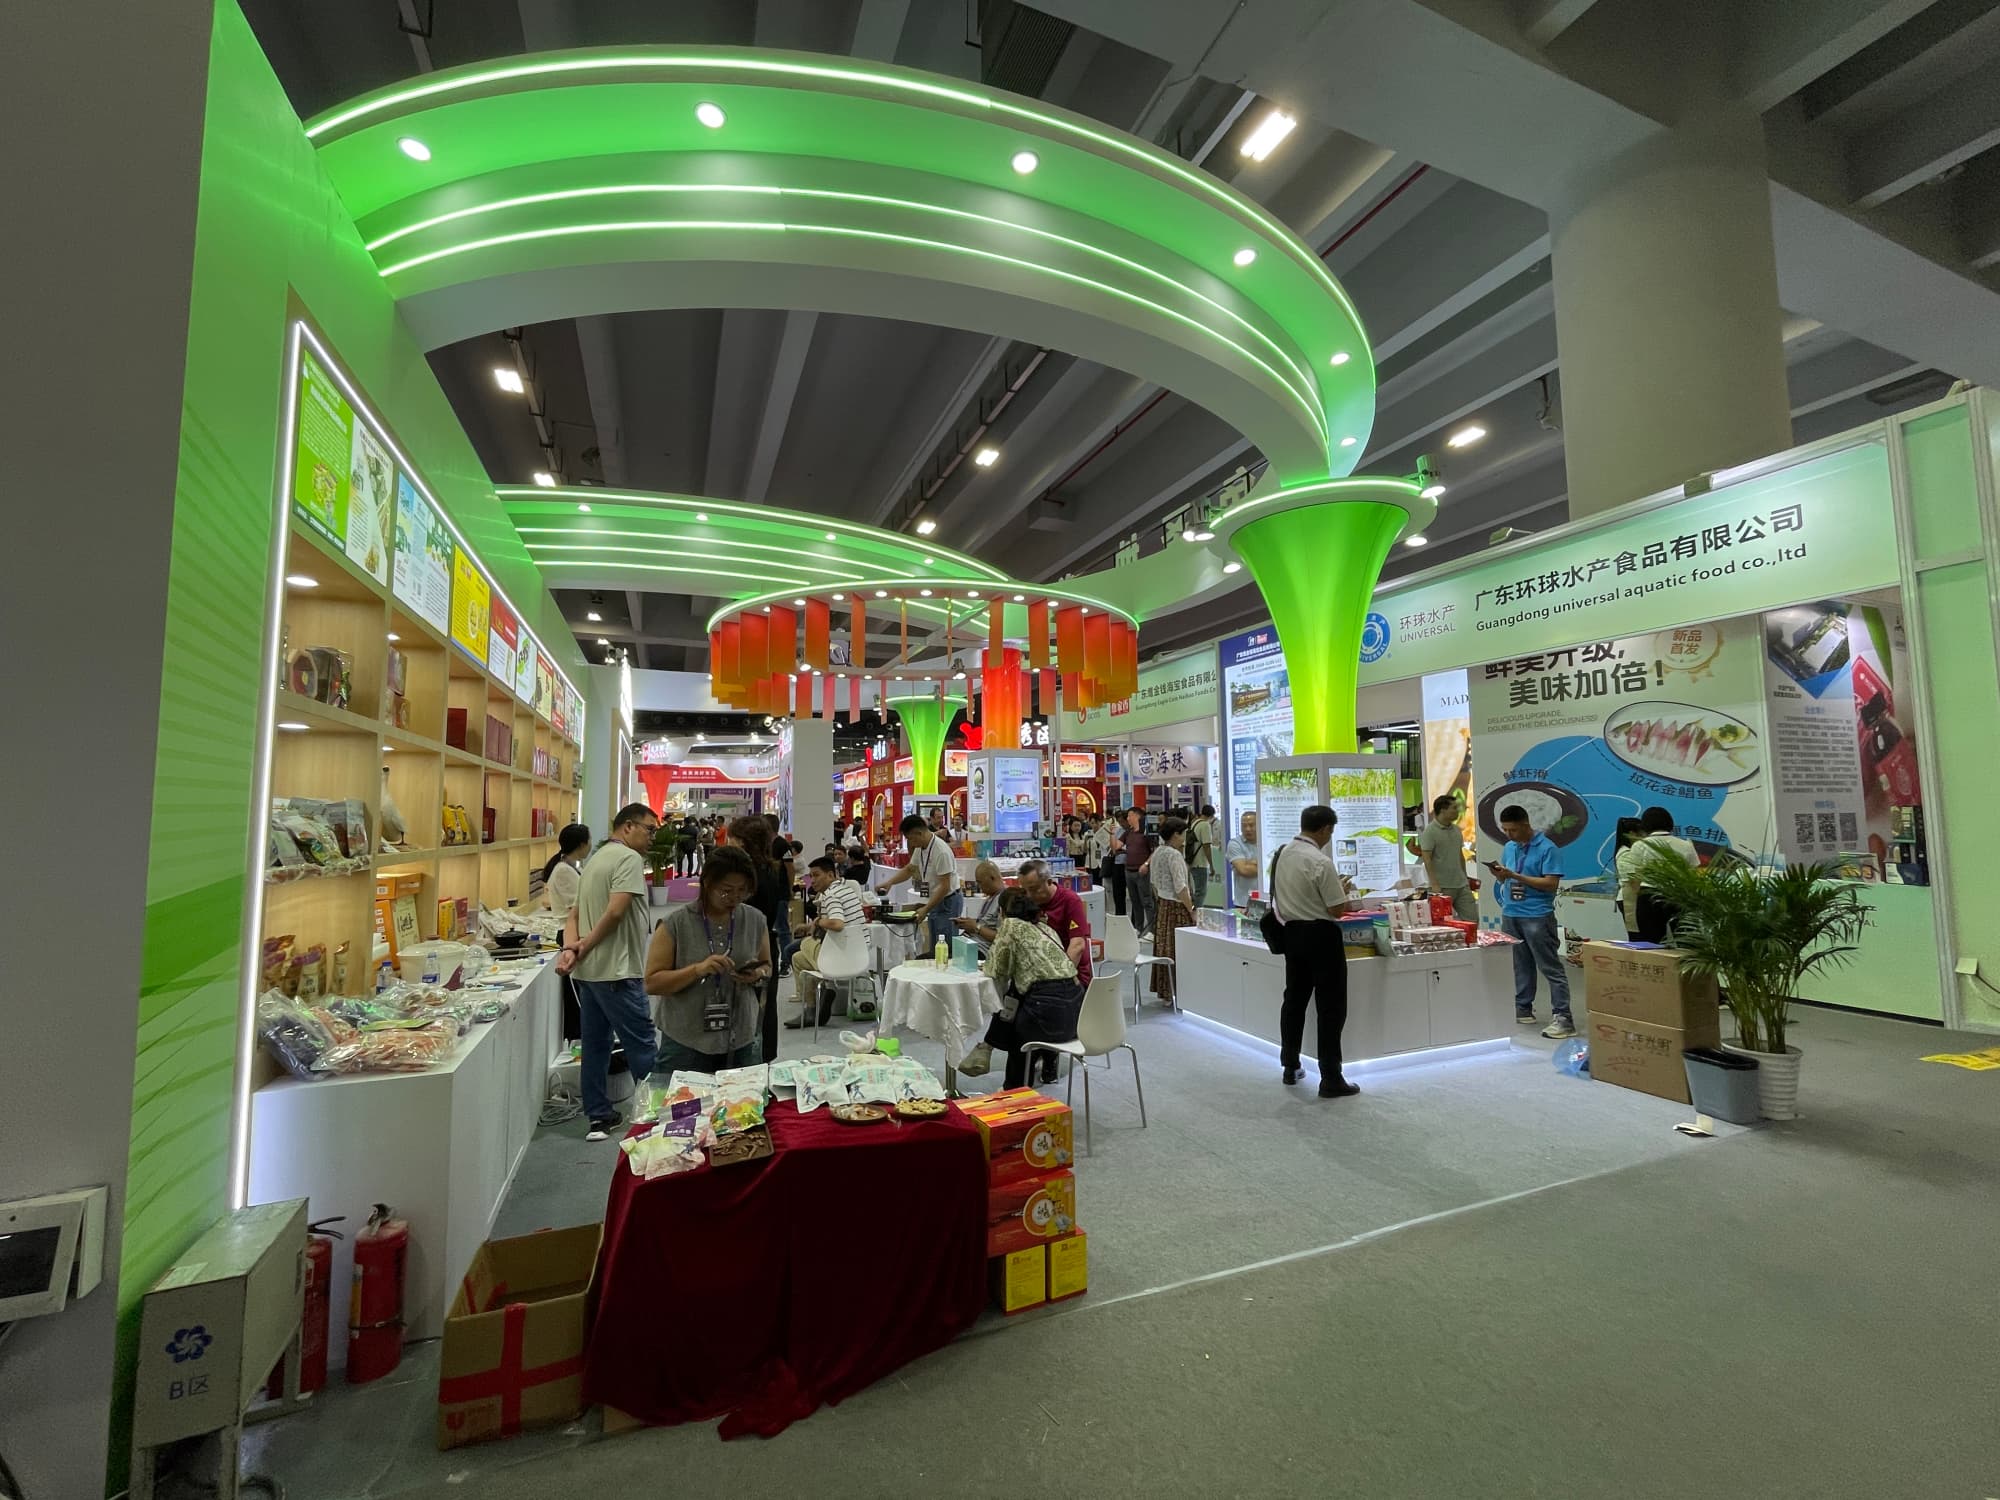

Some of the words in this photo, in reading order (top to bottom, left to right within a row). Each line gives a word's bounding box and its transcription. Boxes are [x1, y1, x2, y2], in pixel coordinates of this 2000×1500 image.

[1475, 504, 1803, 611] 广东环球水产食品有限公司
[1476, 607, 1549, 631] Guangdong
[1554, 588, 1620, 614] universal
[1624, 574, 1688, 598] aquatic
[1692, 560, 1736, 582] food
[1741, 543, 1807, 570] co.,ltd
[1400, 604, 1455, 630] 环球水产
[1400, 622, 1456, 643] UNIVERSAL
[1673, 630, 1703, 642] 新品
[1671, 643, 1699, 655] 首发
[1155, 746, 1188, 775] 海珠
[1628, 772, 1715, 800] 拉花金鲳鱼
[169, 1374, 210, 1400] B区
